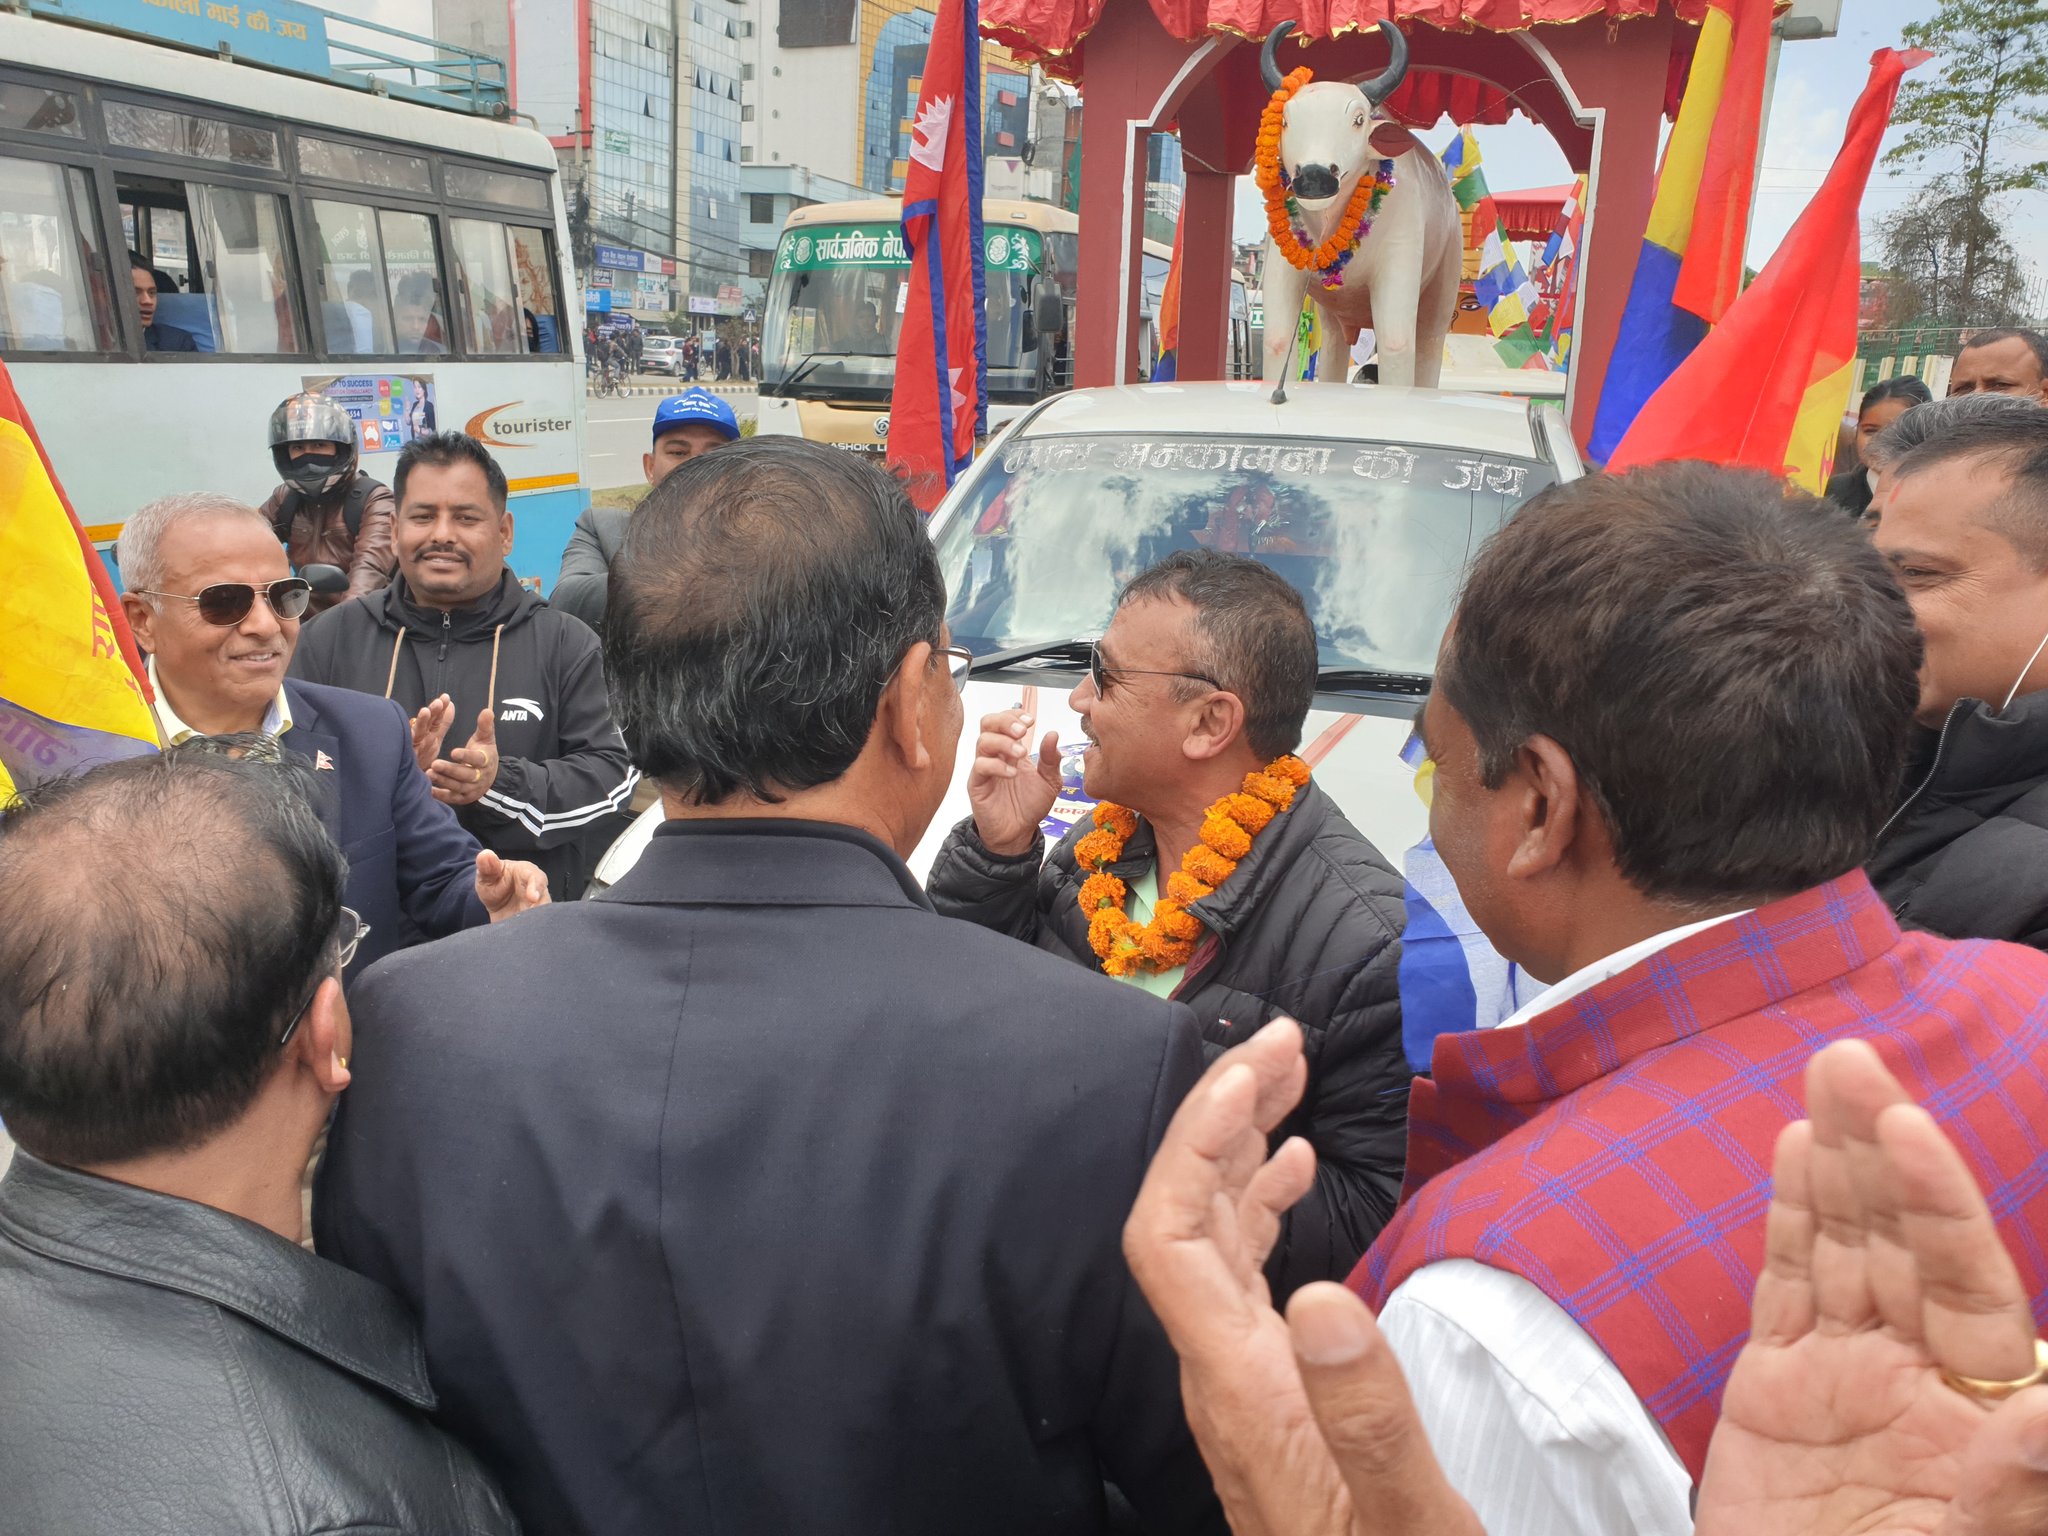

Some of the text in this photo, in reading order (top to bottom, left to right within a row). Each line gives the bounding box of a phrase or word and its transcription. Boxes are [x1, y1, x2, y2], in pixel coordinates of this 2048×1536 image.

[206, 2, 241, 29] माई
[246, 10, 271, 32] की
[275, 19, 309, 41] जय
[815, 230, 880, 262] सार्वजनिक
[347, 379, 373, 388] SUCCESS
[493, 418, 572, 435] tourister
[829, 442, 871, 452] ASHOK
[1441, 458, 1529, 497] जय
[500, 709, 528, 721] ANTA
